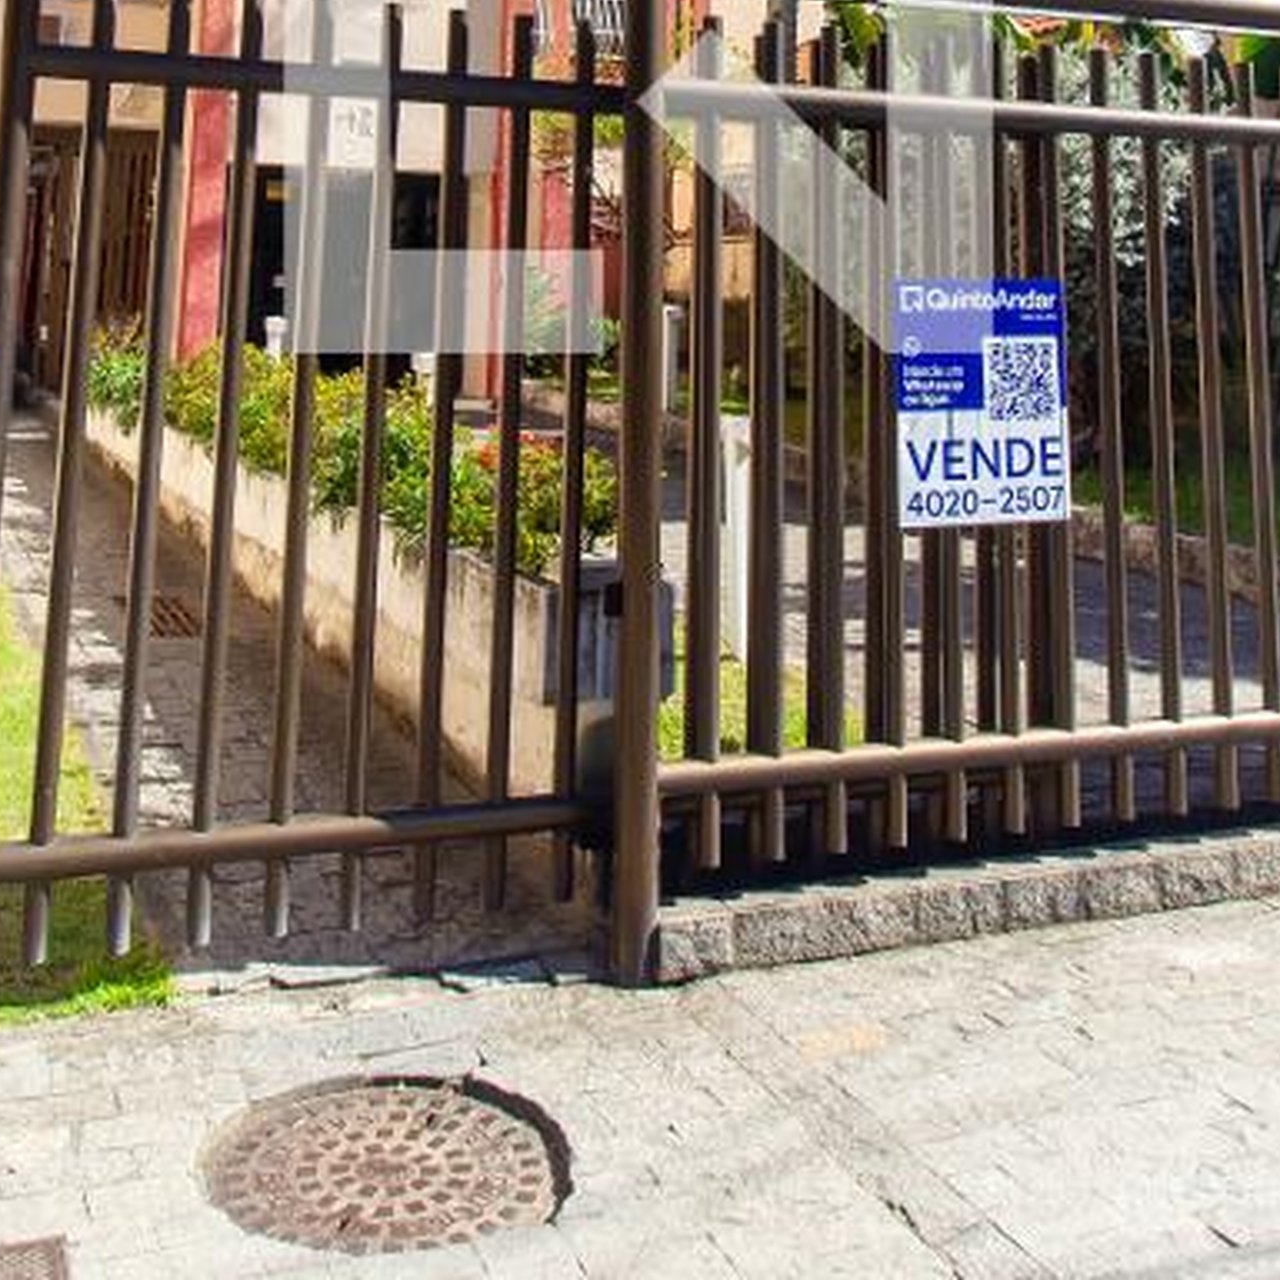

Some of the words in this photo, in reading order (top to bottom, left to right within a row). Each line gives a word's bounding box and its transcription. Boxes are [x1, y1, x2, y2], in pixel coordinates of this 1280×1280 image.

[926, 287, 1057, 311] QuintoAndar
[906, 437, 1063, 481] VENDE
[906, 485, 1065, 517] 4020-2507
